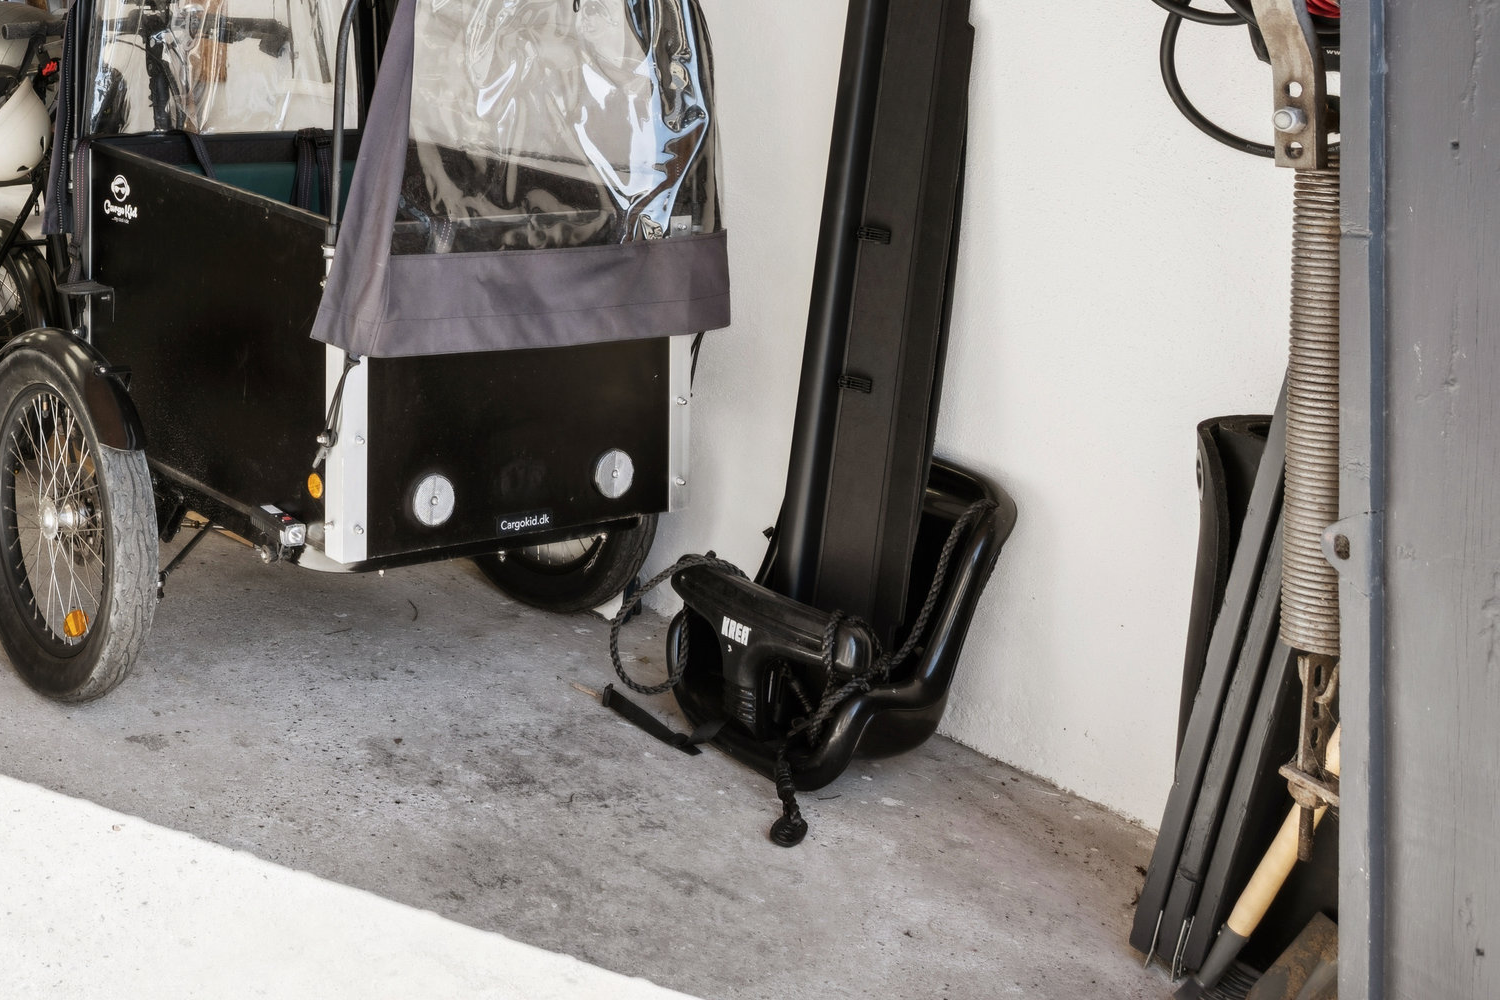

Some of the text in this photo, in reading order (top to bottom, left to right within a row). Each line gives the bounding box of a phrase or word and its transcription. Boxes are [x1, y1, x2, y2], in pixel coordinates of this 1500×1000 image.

[103, 199, 138, 219] Cargo Kid
[500, 513, 550, 531] Cargokid.dk
[721, 615, 750, 647] KREA
